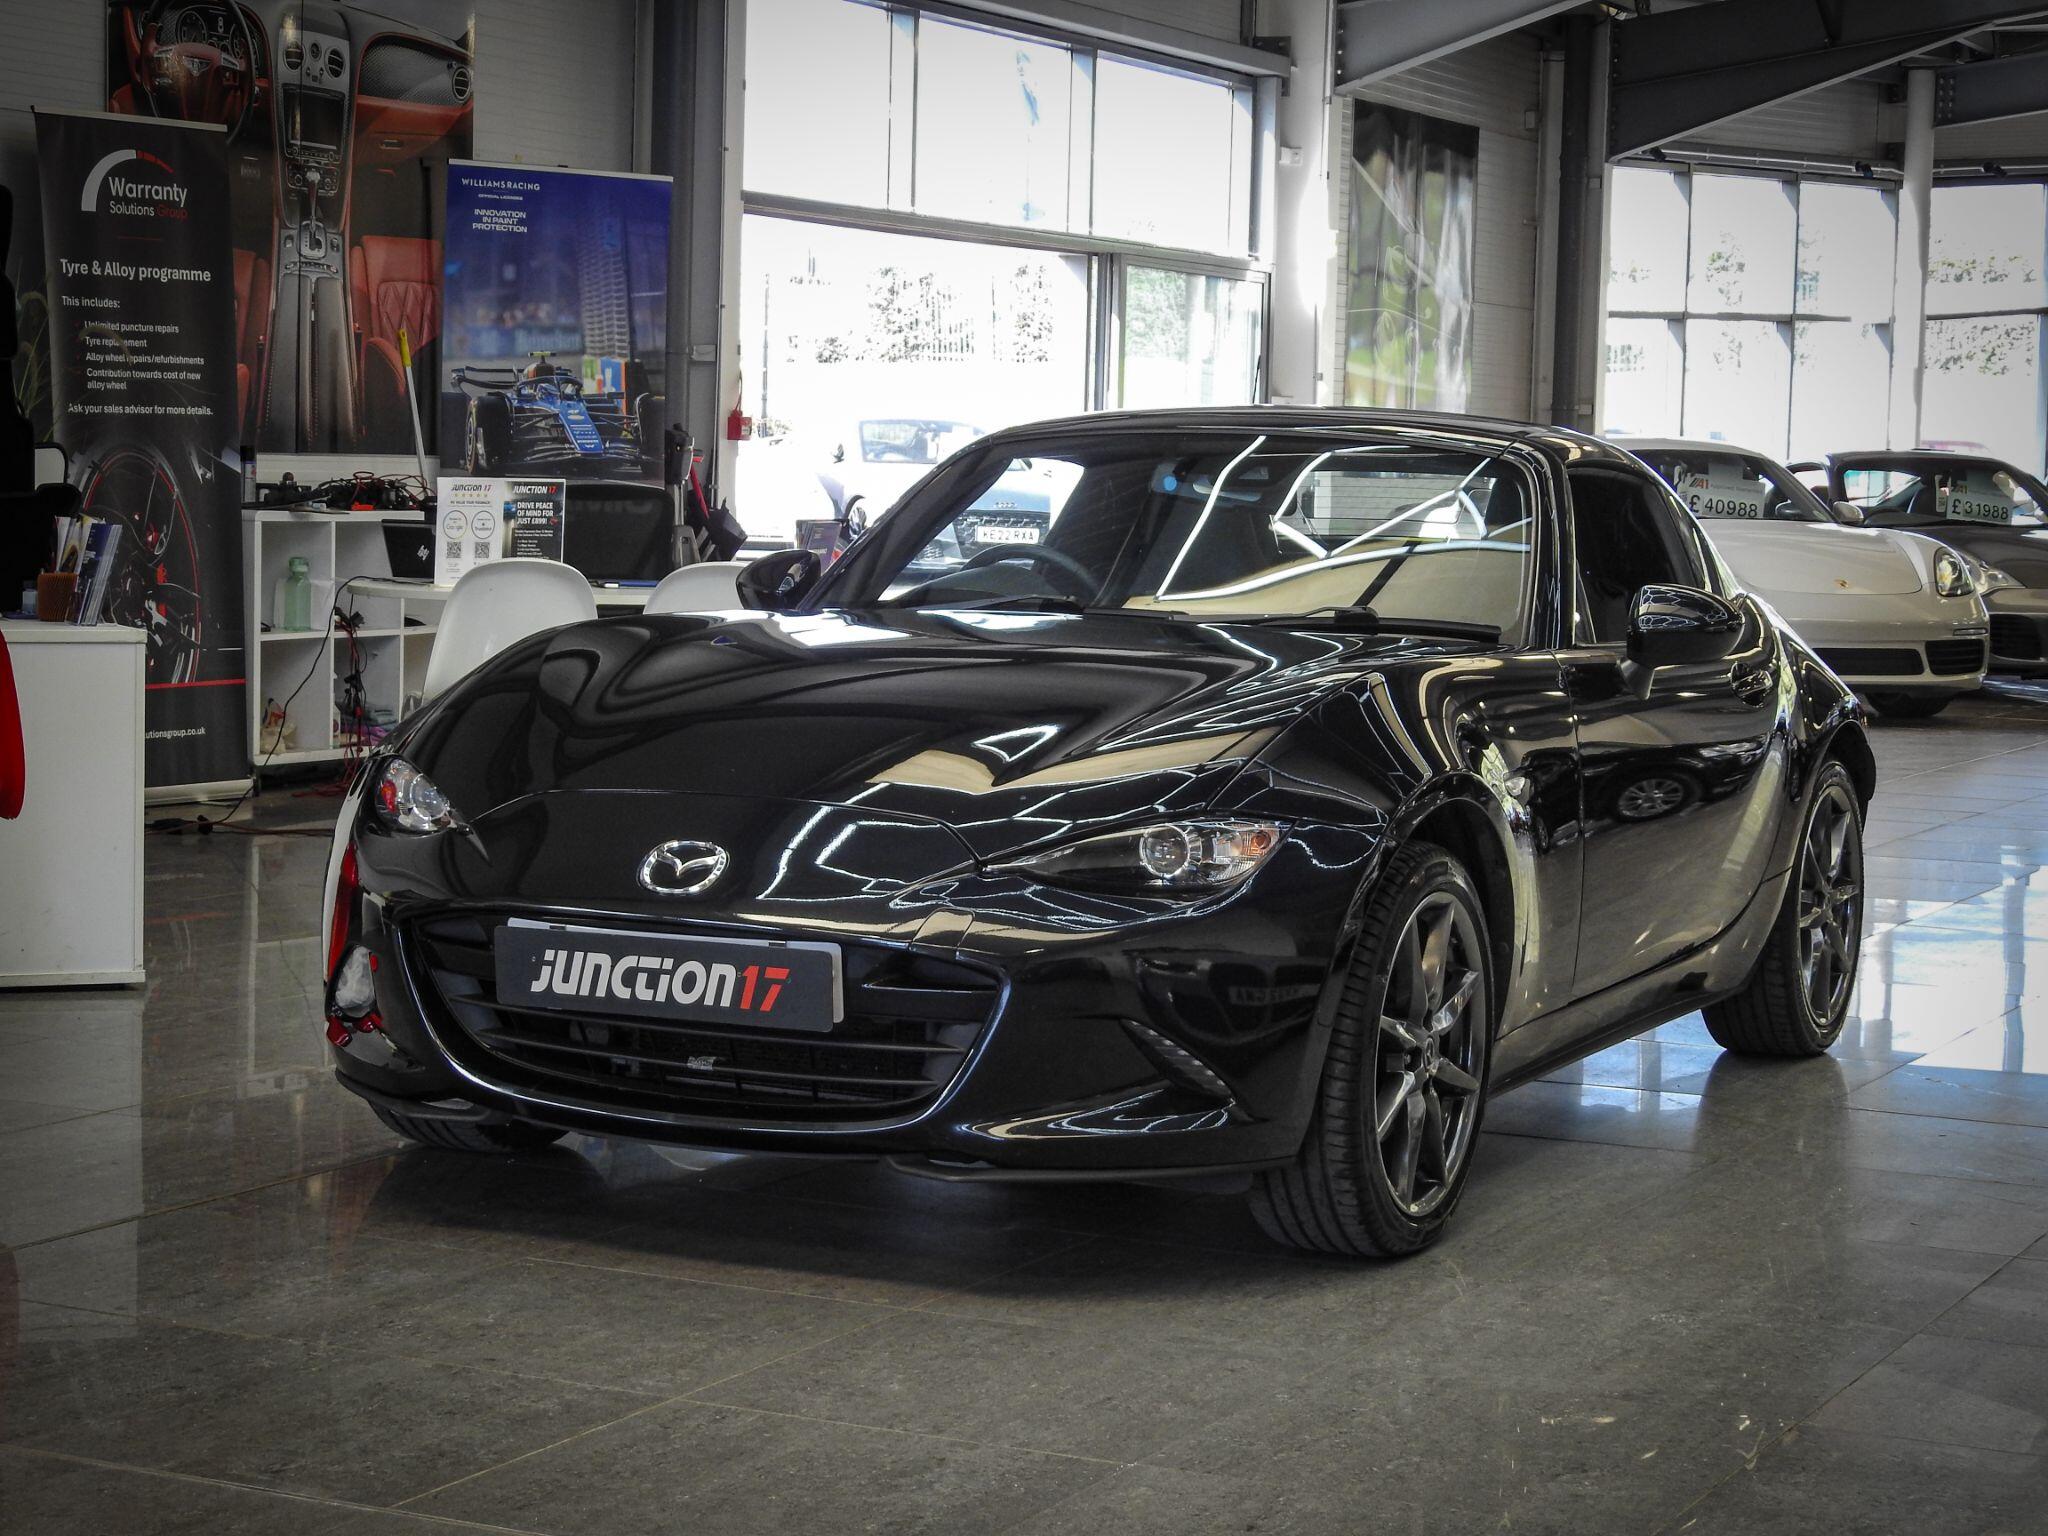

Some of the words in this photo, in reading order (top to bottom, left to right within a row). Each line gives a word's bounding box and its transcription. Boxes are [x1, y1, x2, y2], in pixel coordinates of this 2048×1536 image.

[108, 177, 188, 208] Warranty
[110, 201, 154, 216] Solutions
[157, 204, 188, 220] Group
[474, 208, 526, 218] INNOVATION
[492, 216, 518, 224] PAINT
[472, 222, 528, 232] PROTECTION
[60, 258, 88, 276] Tyre
[92, 260, 101, 276] &
[104, 262, 136, 280] Alloy
[139, 266, 212, 282] programme
[62, 296, 80, 306] This
[82, 297, 120, 308] includes:
[120, 323, 154, 334] puncture
[155, 324, 180, 334] repairs
[86, 337, 100, 346] Tyre
[86, 352, 105, 362] Alloy
[106, 354, 126, 362] wheel
[86, 368, 132, 378] Contribution
[132, 370, 162, 378] towards
[164, 372, 178, 380] cost
[179, 371, 186, 380] of
[186, 372, 202, 380] new
[88, 380, 106, 390] alloy
[106, 381, 127, 390] wheel
[68, 404, 84, 413] Ask
[84, 406, 102, 415] your
[104, 404, 124, 414] sales
[124, 404, 153, 414] advisor
[154, 405, 166, 414] for
[166, 406, 186, 414] more
[186, 406, 214, 416] details.
[512, 486, 548, 494] JUNCTION
[548, 486, 556, 494] 17
[146, 727, 206, 739] utionsgroup.co.uk
